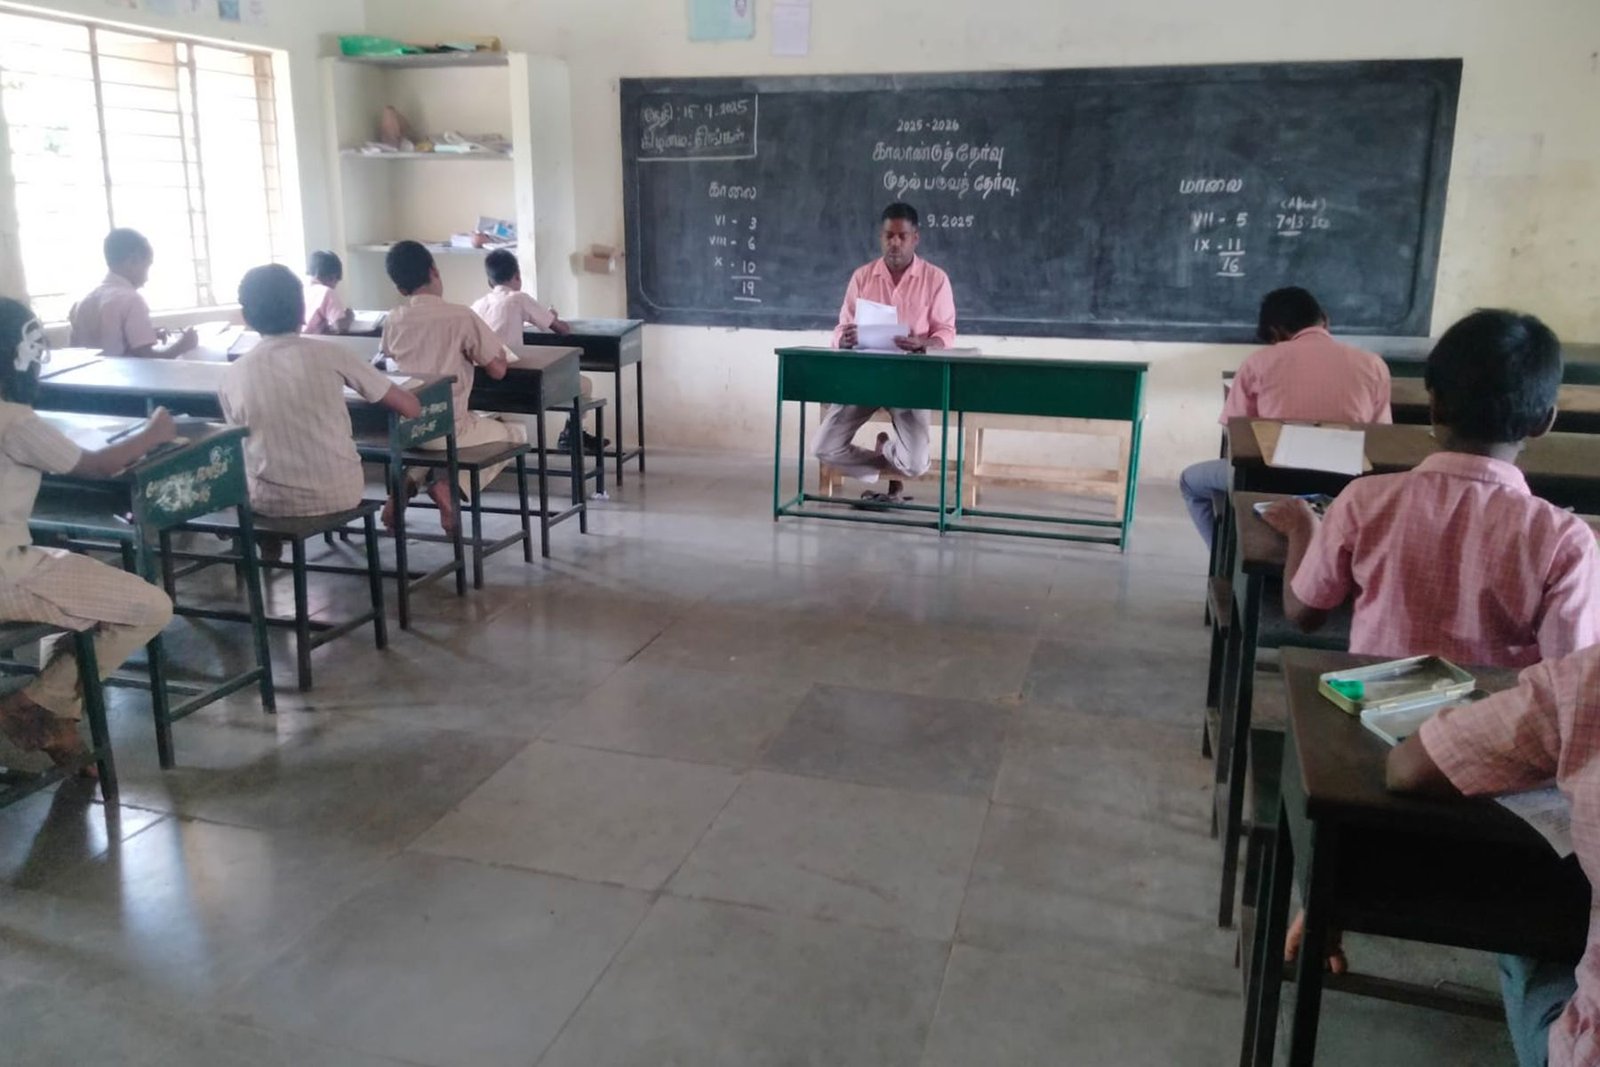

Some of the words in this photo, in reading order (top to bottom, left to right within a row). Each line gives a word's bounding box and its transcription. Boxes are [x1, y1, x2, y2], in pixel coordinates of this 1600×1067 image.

[708, 181, 757, 200] காலை
[1180, 178, 1243, 194] மாலை
[714, 214, 726, 226] VI
[748, 216, 757, 230] 3
[1192, 211, 1214, 228] VII
[1236, 211, 1248, 228] 5
[708, 235, 727, 247] VIII
[747, 236, 756, 251] 6
[1227, 238, 1241, 251] 11
[742, 260, 756, 274] 10
[1222, 257, 1240, 273] 16
[742, 281, 755, 296] 19
